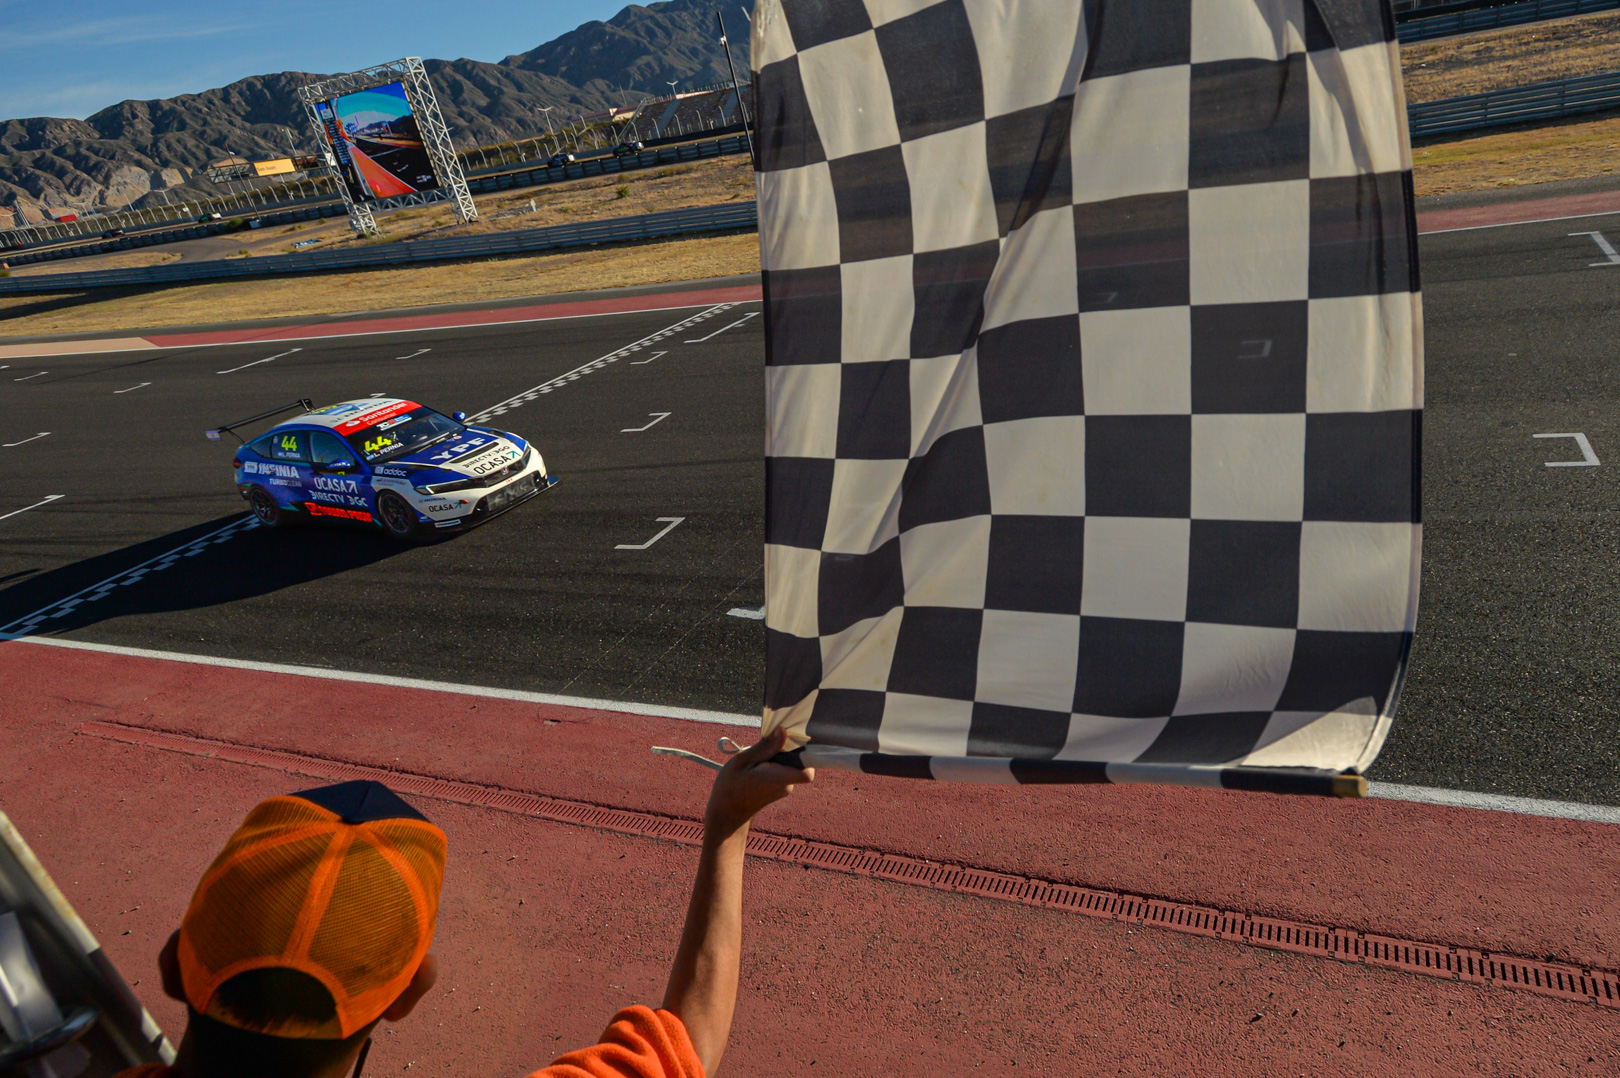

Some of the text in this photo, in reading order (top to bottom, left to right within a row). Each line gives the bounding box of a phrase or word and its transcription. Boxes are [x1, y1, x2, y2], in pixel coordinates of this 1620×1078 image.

[359, 402, 407, 422] Santander
[281, 435, 297, 451] 44
[365, 436, 392, 452] 44
[430, 437, 485, 460] YPF
[383, 467, 407, 476] addoc
[473, 455, 512, 475] OCASA
[313, 477, 347, 494] OCASA
[428, 503, 454, 512] OCASA
